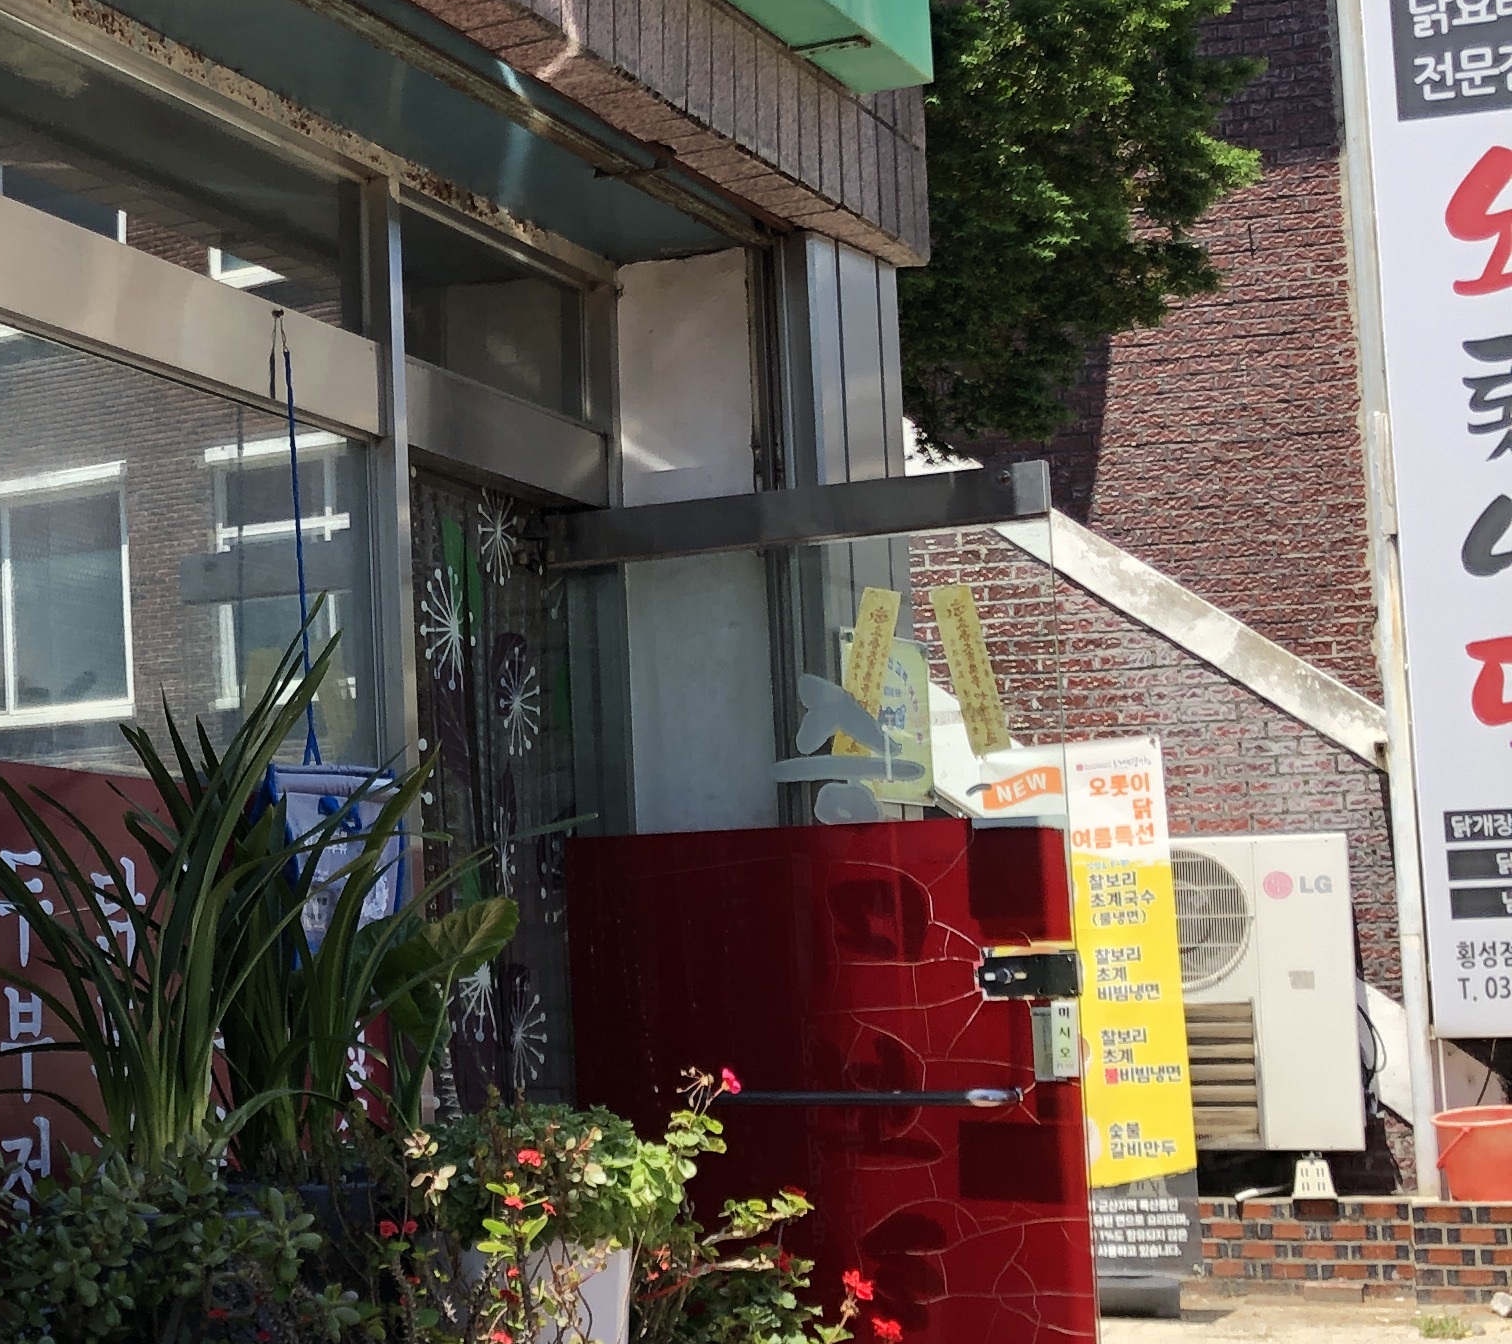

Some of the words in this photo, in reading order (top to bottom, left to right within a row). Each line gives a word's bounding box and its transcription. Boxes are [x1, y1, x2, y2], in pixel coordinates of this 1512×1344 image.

[995, 772, 1047, 804] NEW
[1089, 772, 1150, 797] 오롯이
[1132, 797, 1153, 820] 닭
[1089, 871, 1137, 891] 찰보리
[1299, 874, 1333, 894] LG
[1090, 889, 1156, 908] 초계국수
[1092, 909, 1147, 926] (물냉면)
[1095, 946, 1141, 965] 찰보리
[1096, 966, 1127, 982] 초계
[1097, 983, 1161, 1002] 비빔냉면
[1457, 977, 1479, 1002] T.
[1058, 1007, 1071, 1058] 미시오
[1101, 1028, 1147, 1046] 찰보리
[1103, 1048, 1134, 1064] 초계
[1109, 1122, 1140, 1140] 숯불
[1110, 1139, 1177, 1160] 갈비만두
